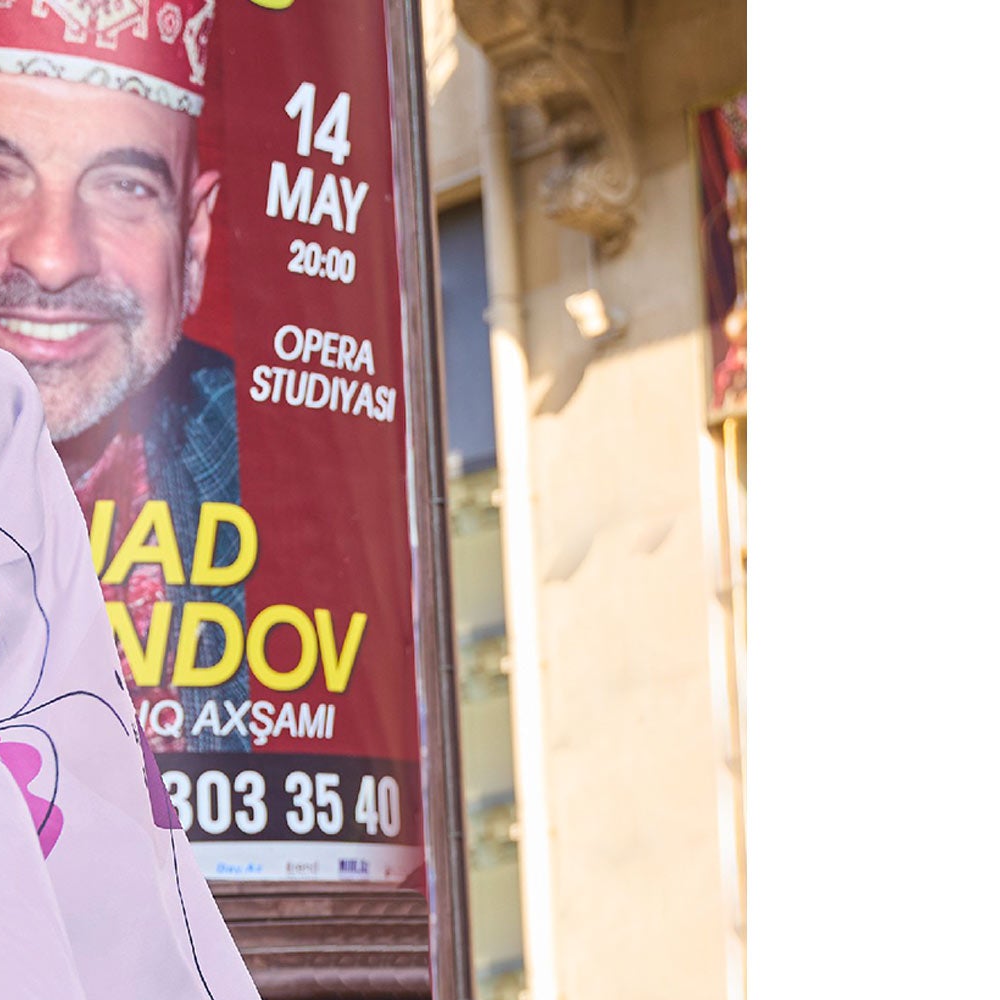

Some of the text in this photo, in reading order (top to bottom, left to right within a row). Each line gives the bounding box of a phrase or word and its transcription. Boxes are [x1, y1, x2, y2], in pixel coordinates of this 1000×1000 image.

[284, 81, 351, 166] 14
[266, 160, 369, 235] MAY
[287, 238, 356, 284] 20:00
[273, 324, 375, 376] OPERA
[250, 364, 396, 422] STUDIYASI
[191, 700, 336, 746] AXŞAMI
[285, 771, 344, 835] 35
[355, 775, 401, 838] 40
